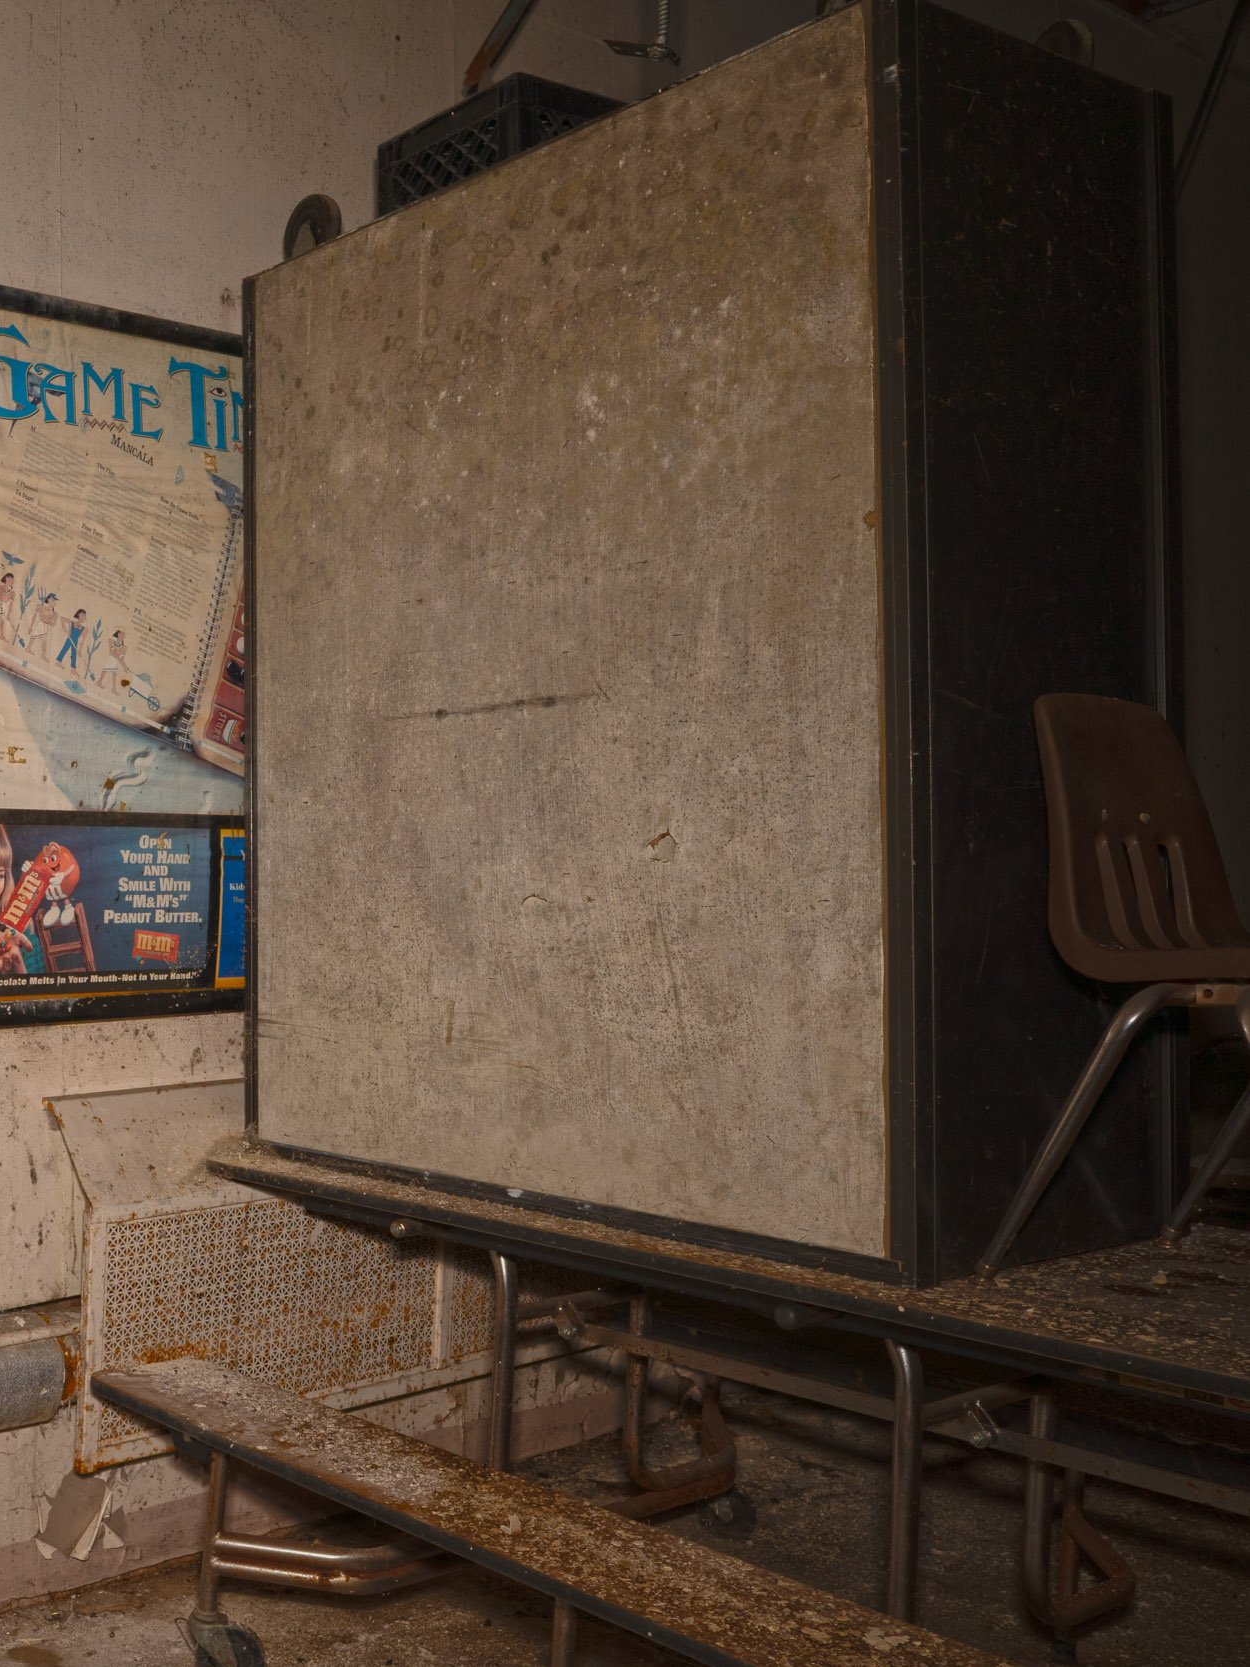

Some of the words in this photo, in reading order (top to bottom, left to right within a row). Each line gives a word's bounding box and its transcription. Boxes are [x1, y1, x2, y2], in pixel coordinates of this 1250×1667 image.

[110, 433, 154, 467] MANCALA
[120, 849, 153, 864] YOUR
[156, 850, 190, 864] HAND
[143, 865, 168, 876] AND
[118, 876, 156, 892] SMILE
[158, 877, 191, 892] WITH
[103, 909, 152, 924] PEANUT
[154, 909, 203, 923] BUTTER.
[29, 976, 55, 985] Melts
[57, 976, 66, 985] In
[68, 975, 88, 984] Your
[90, 973, 137, 983] Mouth-Not
[138, 973, 147, 981] In
[150, 972, 168, 980] Your
